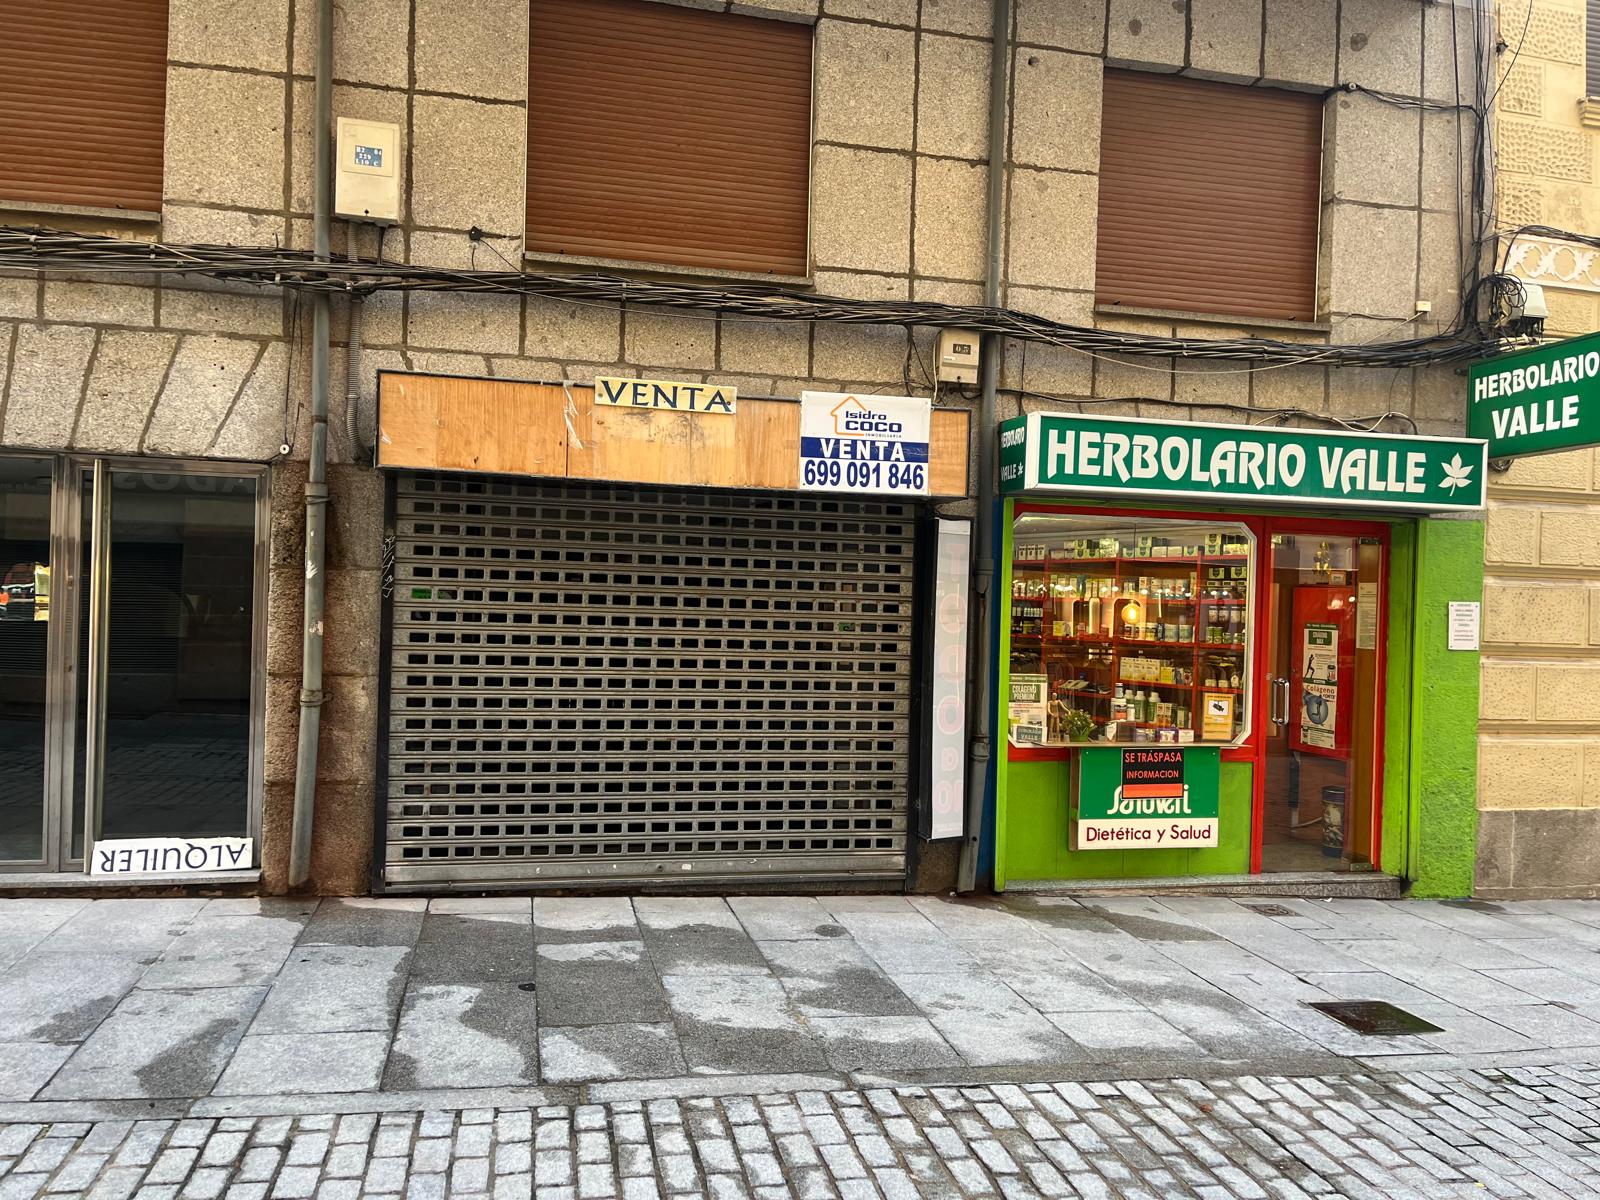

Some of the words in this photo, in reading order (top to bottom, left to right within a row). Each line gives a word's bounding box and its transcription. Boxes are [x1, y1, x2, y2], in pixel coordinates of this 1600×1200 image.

[1474, 351, 1600, 403] HERBOLARIO
[600, 379, 732, 413] VENTA
[845, 410, 887, 421] Isidro
[845, 420, 902, 433] COCO
[1491, 394, 1580, 439] VALLE
[1001, 426, 1025, 448] HERBOLARIO
[820, 437, 906, 462] VENTA
[1000, 464, 1017, 481] VALLE
[1047, 428, 1306, 492] HERBOLARIO
[1318, 445, 1427, 495] VALLE
[804, 460, 839, 487] 699
[846, 461, 881, 488] 091
[888, 462, 924, 490] 846
[1125, 752, 1135, 763] SE
[1137, 751, 1182, 763] TRASPASA
[1126, 770, 1179, 779] INFORMACION
[1086, 826, 1151, 842] Dietética
[1157, 828, 1166, 843] y
[1170, 824, 1211, 840] Salud
[100, 842, 246, 873] ALQUILER
